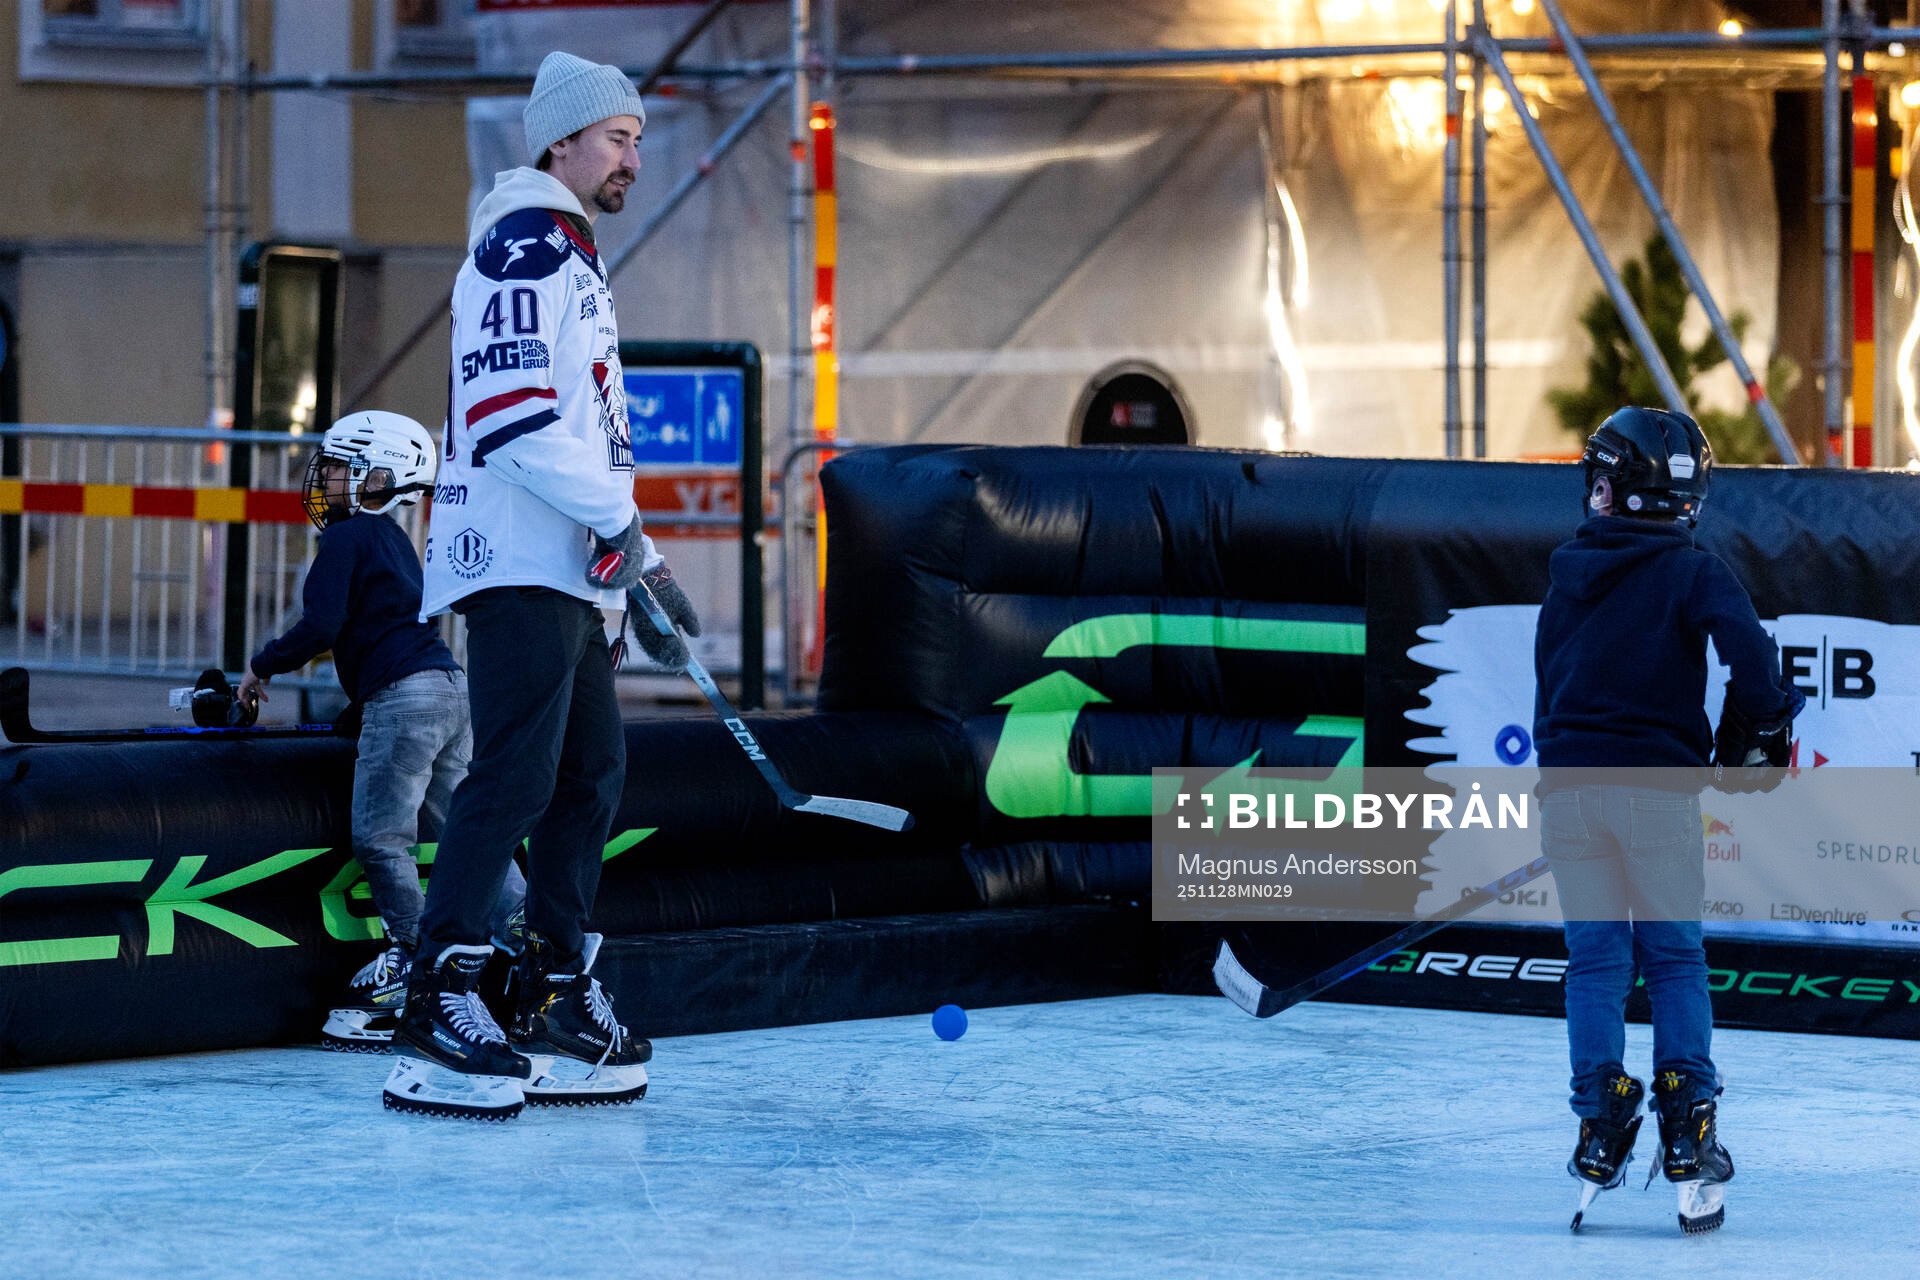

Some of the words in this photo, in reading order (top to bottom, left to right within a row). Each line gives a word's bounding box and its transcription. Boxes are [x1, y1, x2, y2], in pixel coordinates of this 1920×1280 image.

[480, 287, 540, 338] 40
[462, 341, 520, 386] SMG
[383, 449, 409, 460] CCM
[1597, 451, 1617, 466] CCM
[724, 717, 767, 761] CCM
[1707, 843, 1741, 862] Bull
[431, 1030, 462, 1049] BAUER
